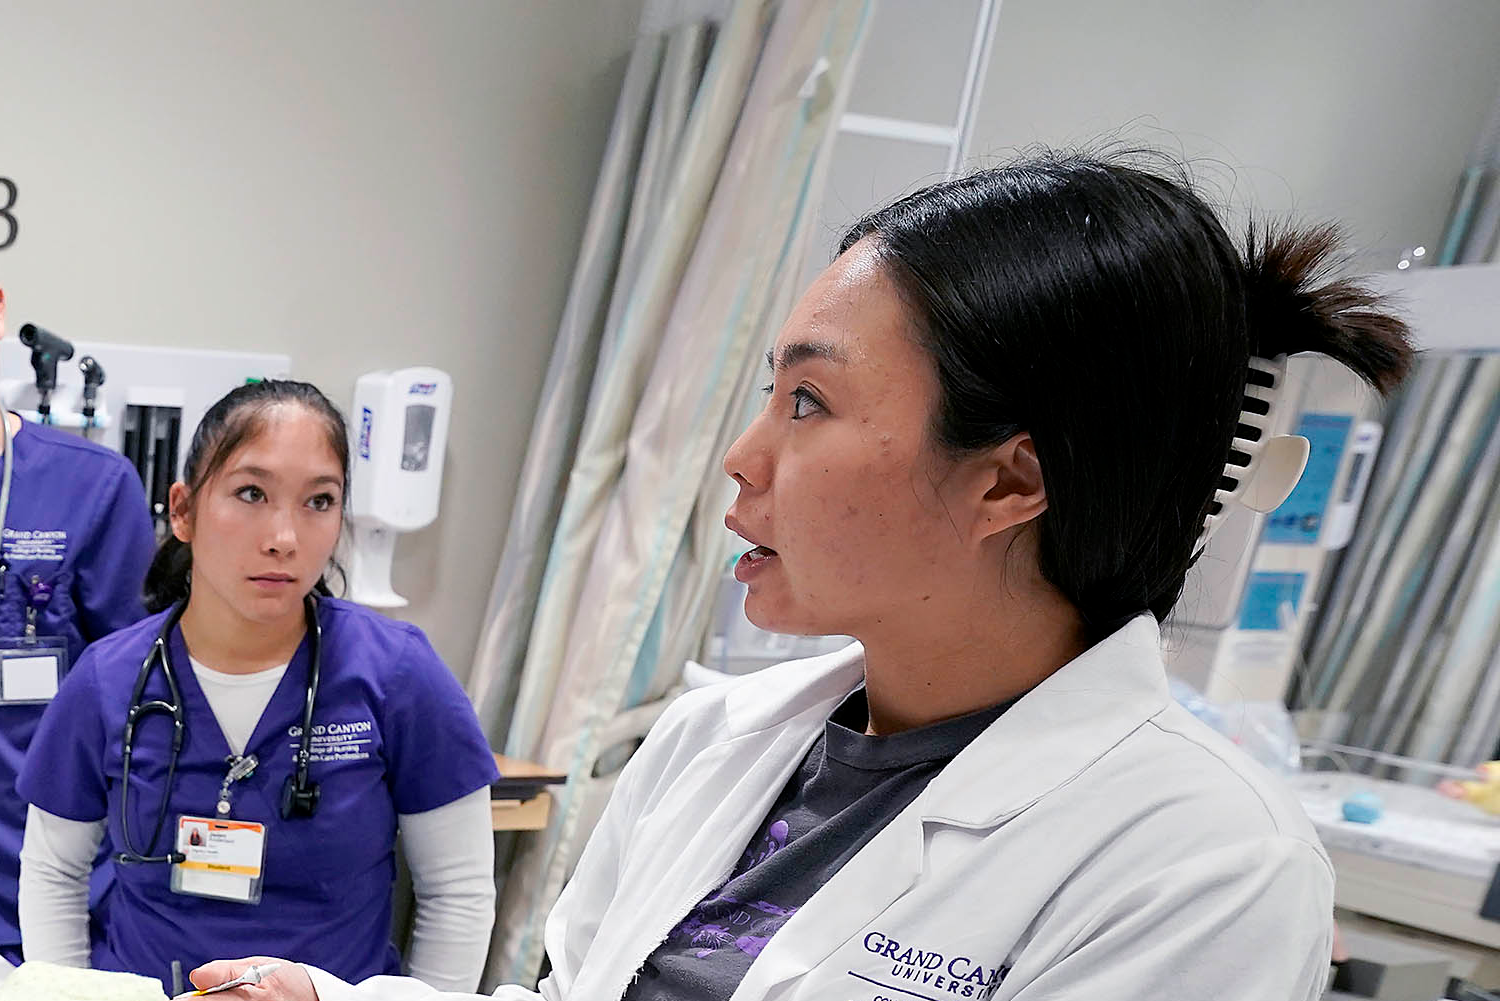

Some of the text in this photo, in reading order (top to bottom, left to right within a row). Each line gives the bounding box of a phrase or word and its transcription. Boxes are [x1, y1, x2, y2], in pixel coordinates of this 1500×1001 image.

[288, 721, 371, 737] GRND CANYON
[863, 931, 944, 971] GRAND
